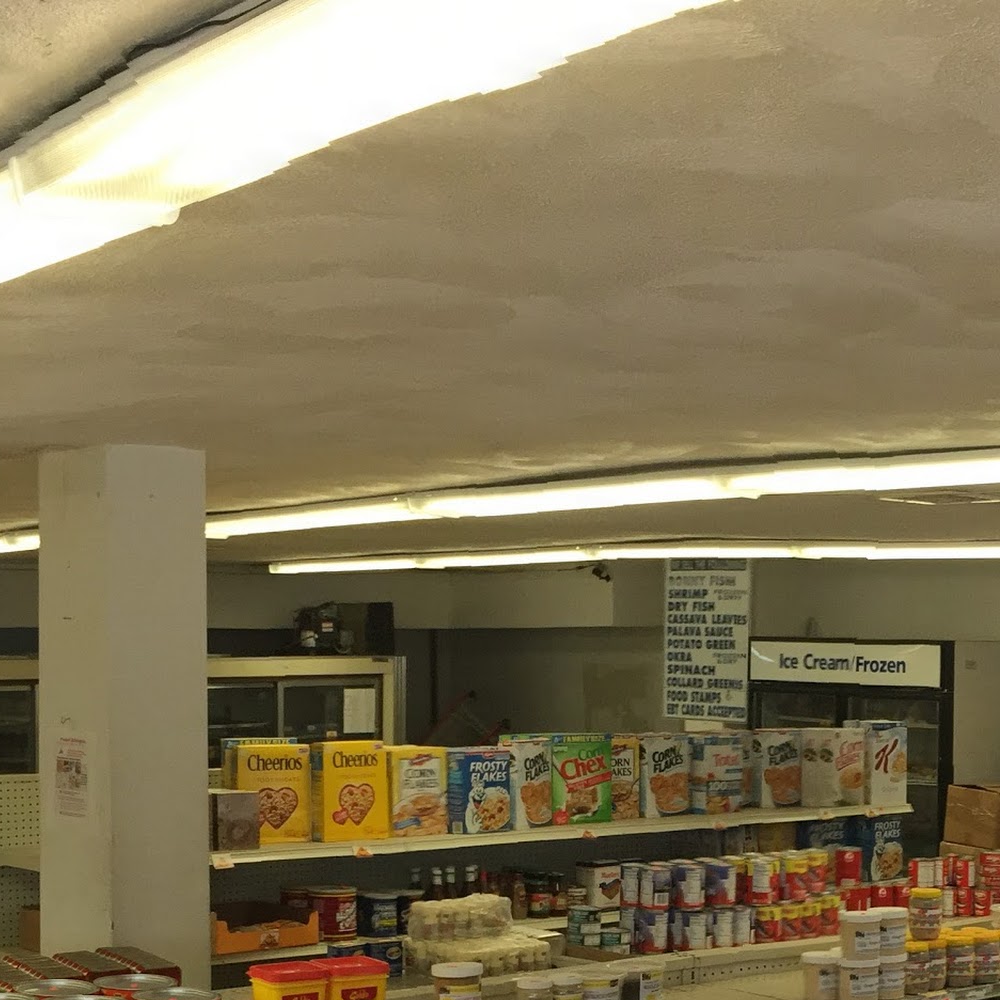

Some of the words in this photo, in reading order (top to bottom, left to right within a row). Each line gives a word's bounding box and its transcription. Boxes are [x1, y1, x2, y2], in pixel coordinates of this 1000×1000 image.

[668, 588, 709, 599] SHRIMP
[668, 601, 688, 612] DRY
[692, 601, 716, 612] FISH
[667, 614, 707, 624] CASSAVA
[667, 626, 701, 636] PALAVA
[704, 626, 733, 637] SAUCE
[667, 638, 702, 649] POTATO
[705, 639, 736, 649] GREEN
[667, 652, 692, 662] OKRA
[779, 653, 798, 669] Ice
[667, 665, 716, 675] SPINACH
[667, 677, 703, 688] COLLARD
[707, 679, 743, 689] GREENS
[667, 690, 688, 702] FOOD
[691, 691, 721, 703] STAMPS
[667, 703, 679, 715] EBT
[682, 704, 704, 716] CARDS
[332, 750, 379, 769] Cheerios
[652, 745, 678, 764] CORN
[247, 754, 303, 772] Cheerios
[470, 760, 507, 772] FROSTY
[524, 752, 546, 771] CORN
[611, 758, 631, 767] ORN
[653, 753, 684, 774] FLAKES
[525, 762, 549, 782] FLAKES
[560, 755, 608, 781] Chex
[611, 767, 632, 776] AKES
[471, 770, 507, 782] FLAKES
[875, 820, 900, 831] FROSTY
[875, 829, 900, 839] FLAKES
